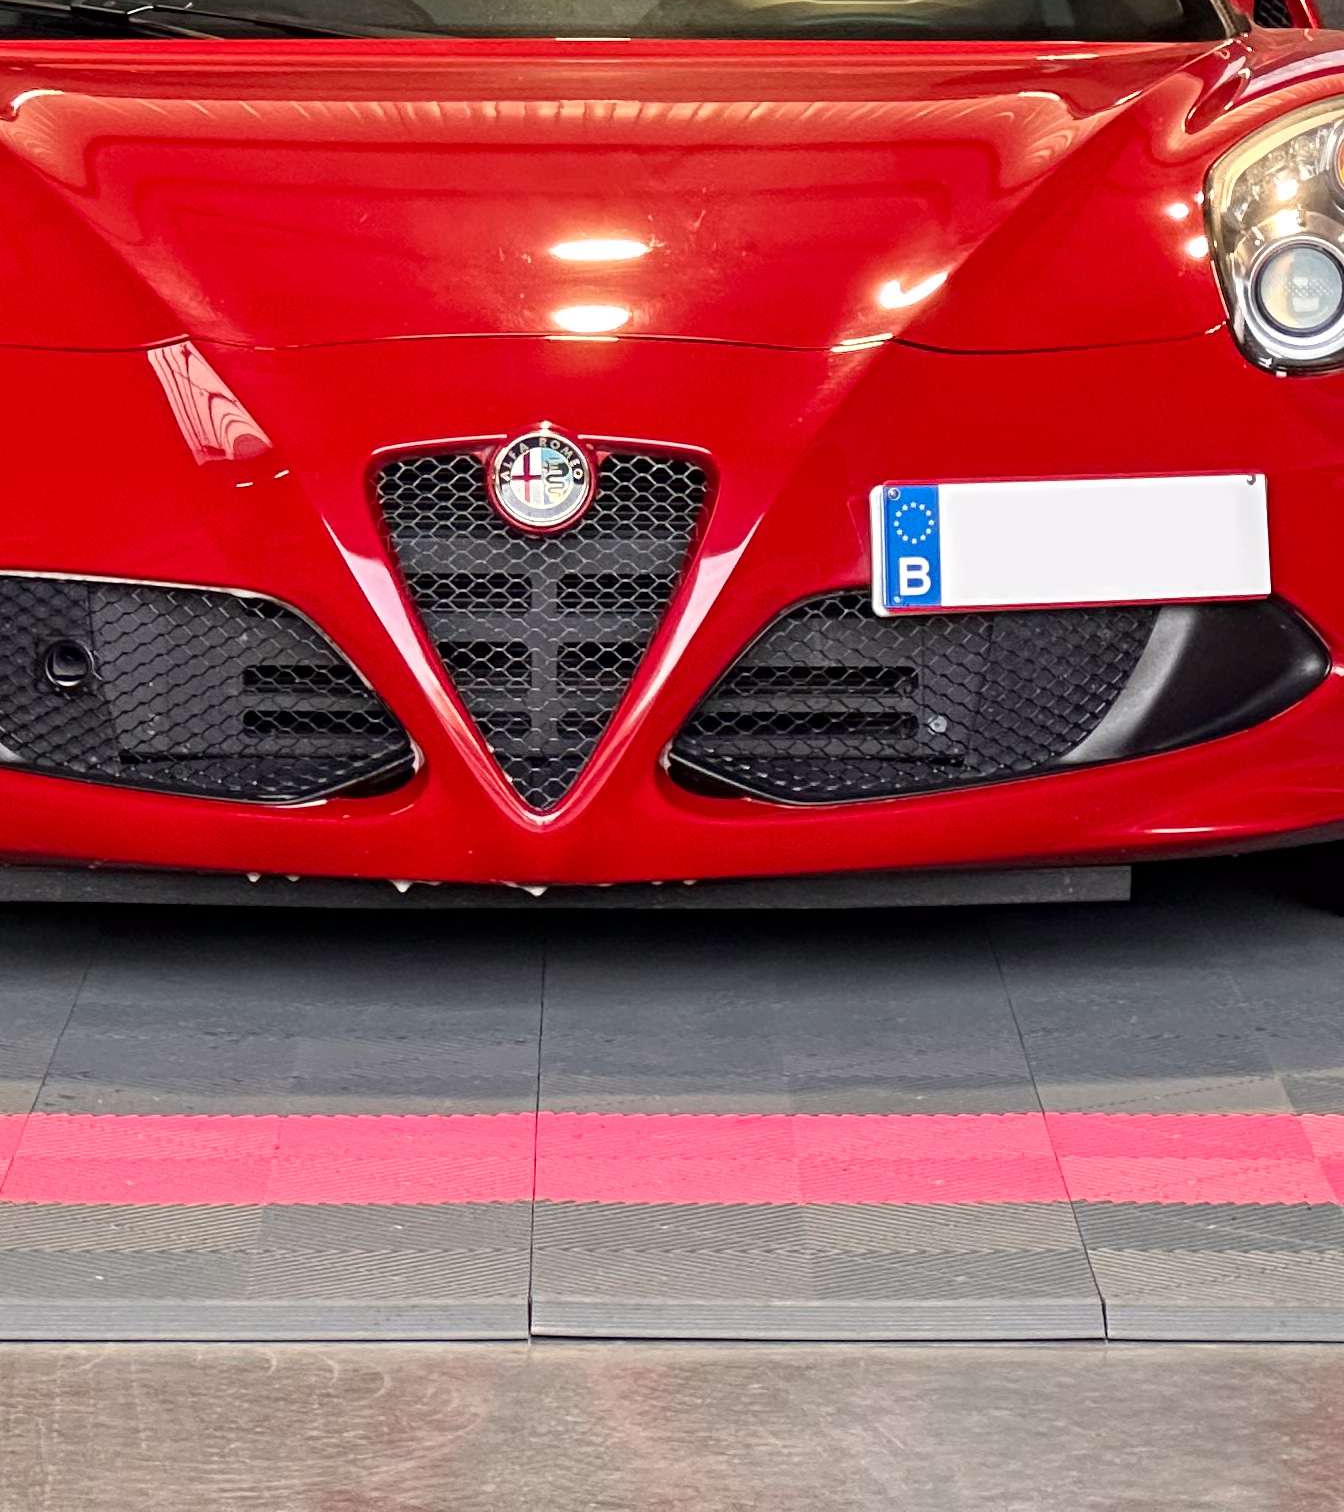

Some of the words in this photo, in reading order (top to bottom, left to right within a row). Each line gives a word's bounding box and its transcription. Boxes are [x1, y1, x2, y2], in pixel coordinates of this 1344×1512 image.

[500, 441, 530, 481] ALFA
[538, 437, 585, 481] ROMEO
[899, 557, 932, 596] B
